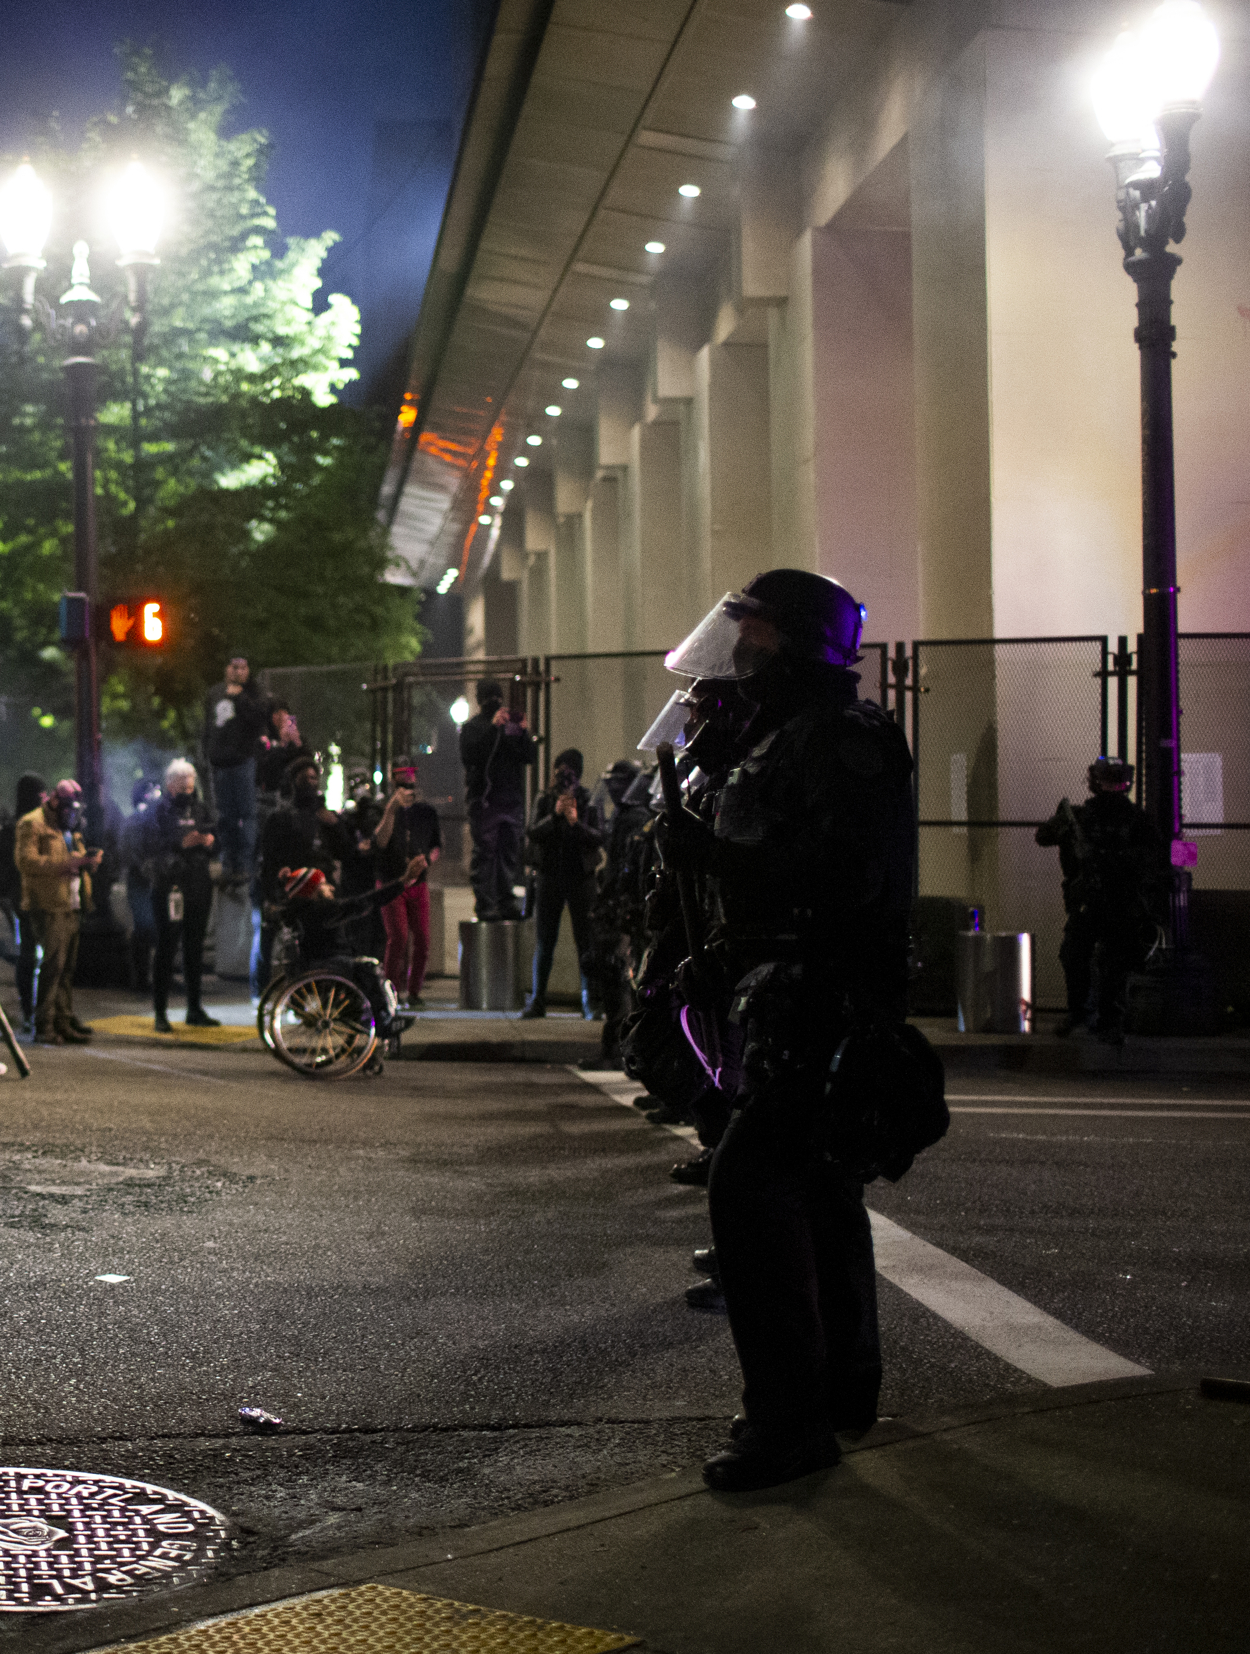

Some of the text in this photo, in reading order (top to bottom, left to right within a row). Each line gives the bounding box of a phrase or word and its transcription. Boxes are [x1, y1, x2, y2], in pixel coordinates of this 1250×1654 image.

[143, 602, 163, 641] 6
[22, 1478, 195, 1534] PORTLAND
[33, 1540, 198, 1594] GENERAL
